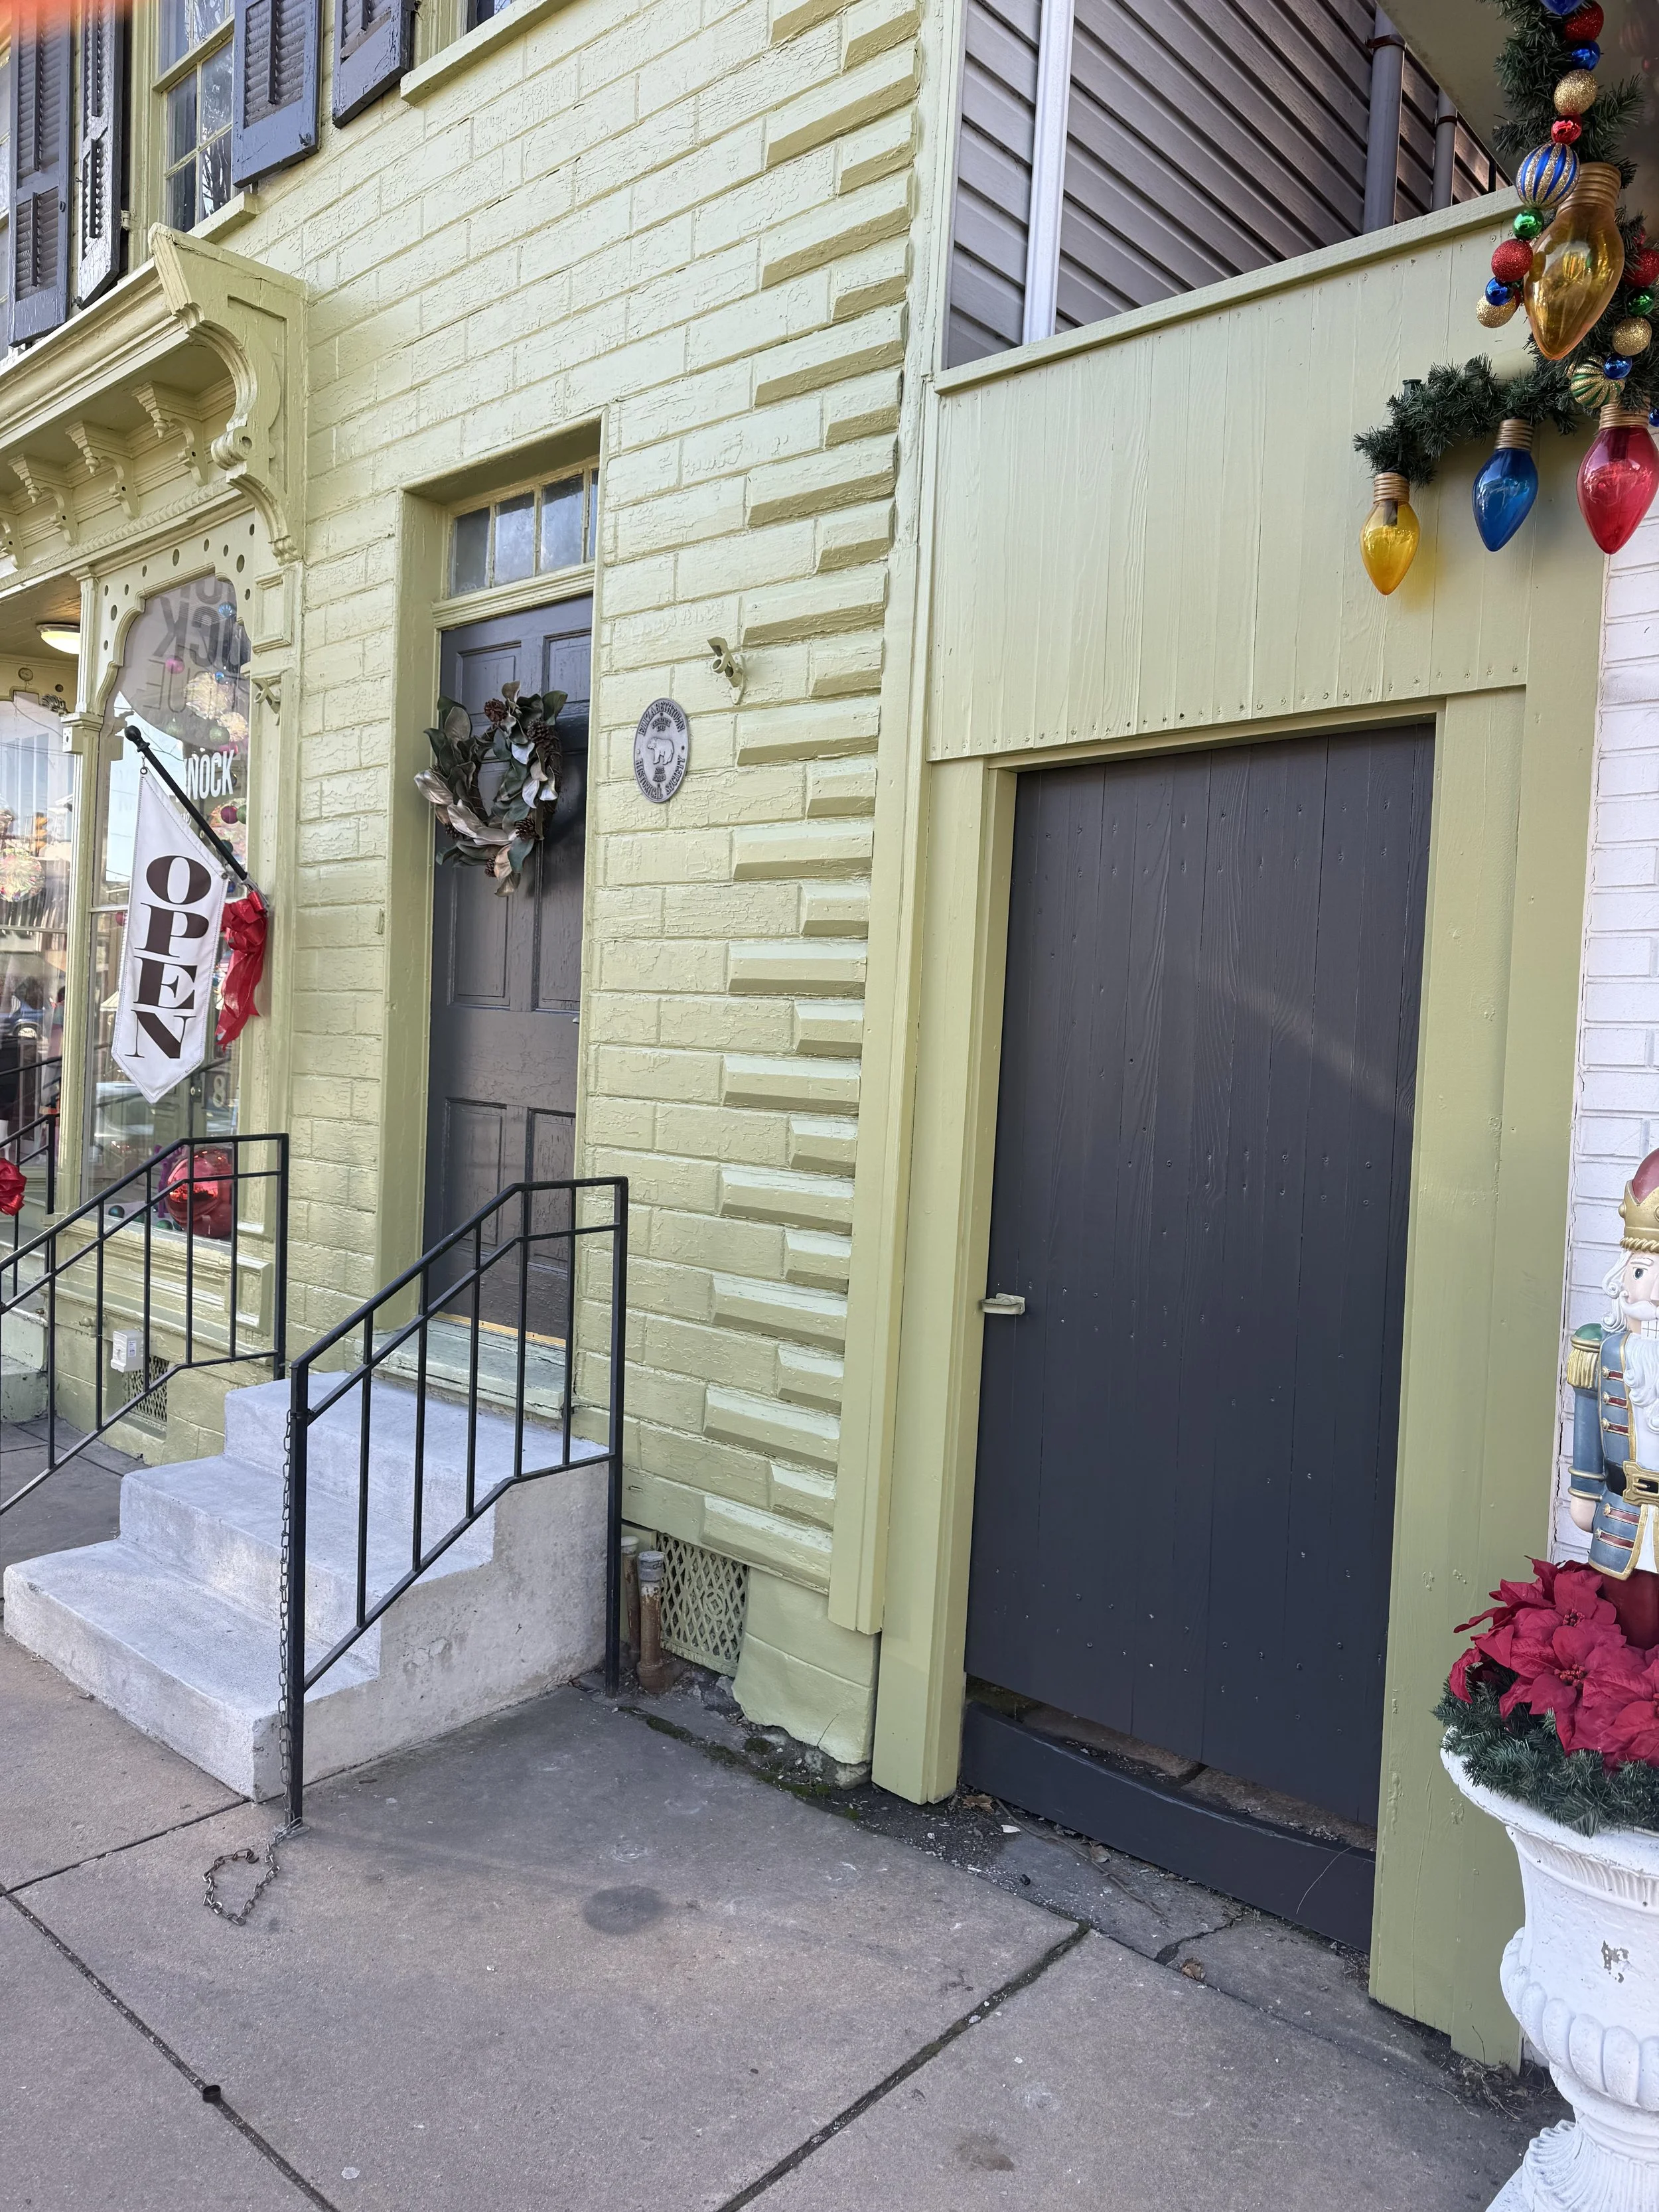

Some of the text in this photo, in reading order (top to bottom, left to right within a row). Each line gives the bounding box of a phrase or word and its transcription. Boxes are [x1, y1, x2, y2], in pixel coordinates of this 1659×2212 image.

[638, 701, 685, 736] ELIZABETHTOWN
[636, 755, 685, 800] HISTORICAL SOCIETY
[125, 854, 212, 1059] OPEN
